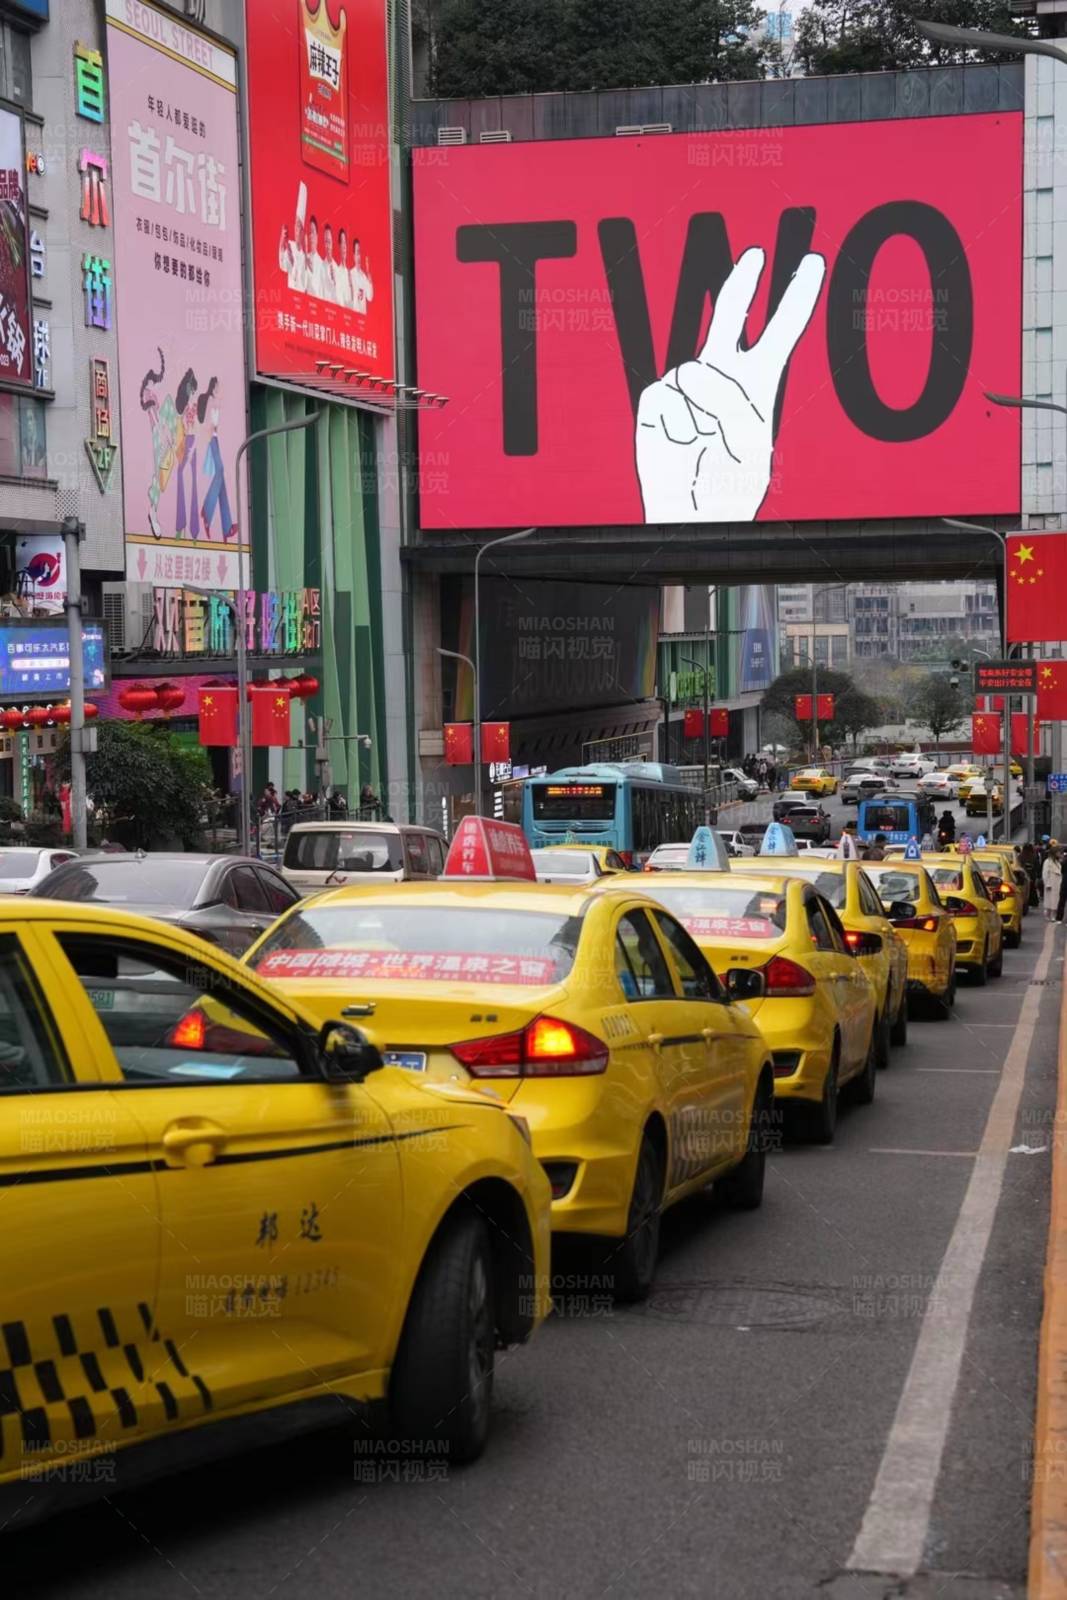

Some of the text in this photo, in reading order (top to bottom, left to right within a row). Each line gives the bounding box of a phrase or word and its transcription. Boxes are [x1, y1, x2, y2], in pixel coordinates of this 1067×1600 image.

[125, 0, 167, 44] SEOUL
[173, 25, 214, 69] STREET
[127, 119, 228, 232] 首尔街
[456, 200, 974, 456] TWO
[95, 370, 111, 439] 商场
[154, 553, 211, 581] 从这里到2楼
